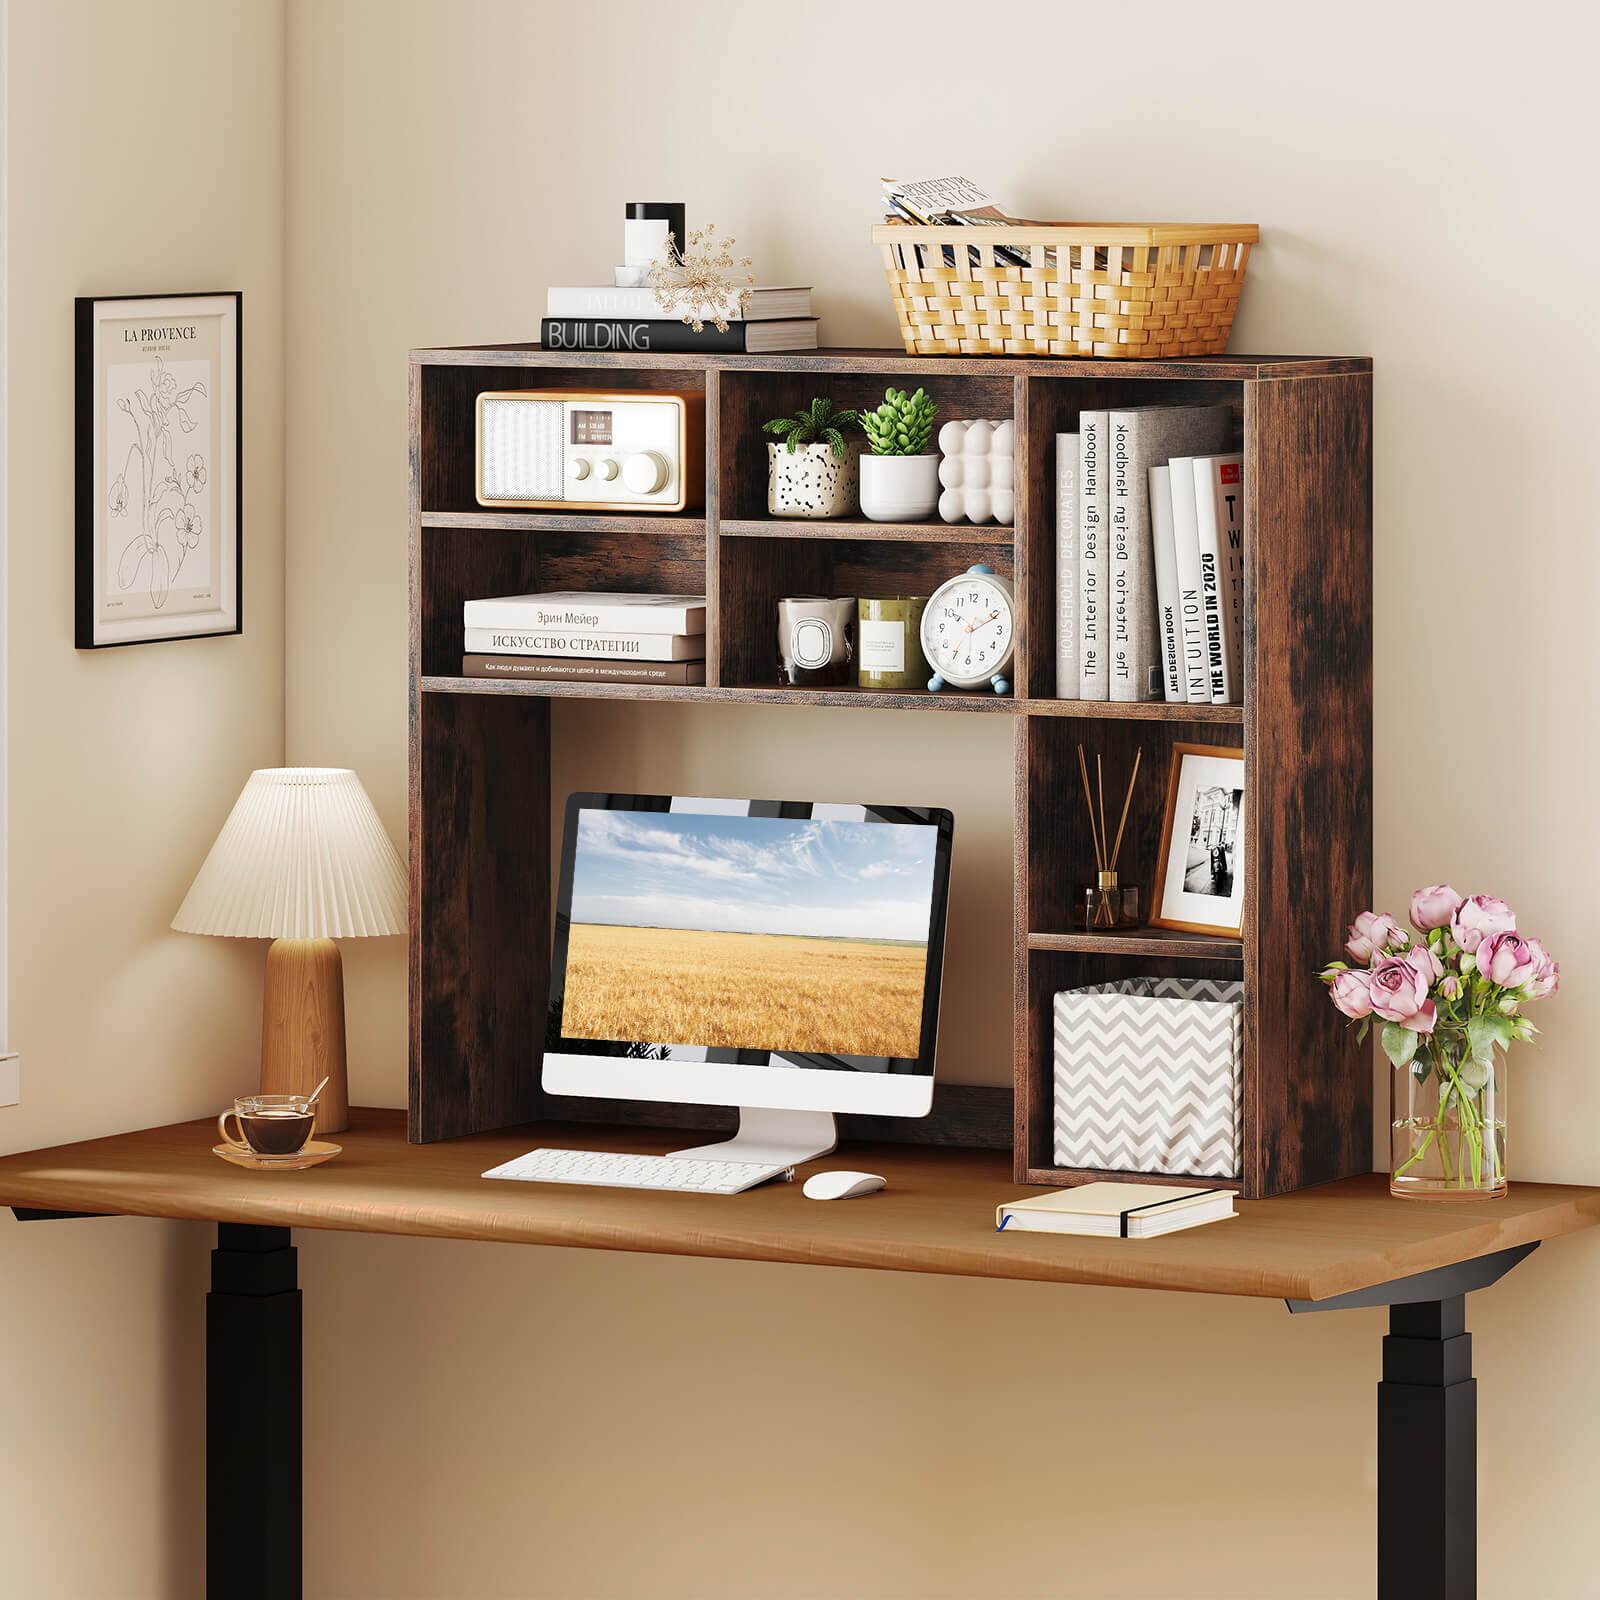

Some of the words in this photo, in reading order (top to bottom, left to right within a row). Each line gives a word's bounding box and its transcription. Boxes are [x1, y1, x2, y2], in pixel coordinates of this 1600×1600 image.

[913, 187, 989, 208] DESIGN
[124, 329, 138, 342] LA
[141, 326, 197, 342] PROVENCE
[548, 322, 650, 350] BUILDING
[1084, 423, 1097, 497] Handbook
[1060, 469, 1074, 559] DECORATES
[1084, 504, 1100, 560] Design
[1202, 553, 1216, 592] 2020
[956, 597, 964, 608] 11
[968, 593, 979, 603] 12
[985, 598, 989, 608] 1
[1084, 568, 1097, 641] Interior
[1205, 595, 1218, 611] IN
[537, 611, 562, 626] Эрин
[564, 611, 599, 628] Мейер
[944, 608, 954, 618] 10
[1060, 568, 1074, 659] HOUSEHOLD
[939, 623, 945, 633] 9
[996, 625, 1003, 635] 3
[492, 634, 566, 650] ИСКУССТВО
[569, 638, 640, 653] СТРАТЕГИИ
[942, 640, 948, 649] 8
[990, 641, 996, 650] 4
[1182, 589, 1205, 696] INTUITION
[1206, 614, 1222, 667] WORLD
[952, 650, 958, 660] 7
[964, 655, 971, 665] 6
[978, 651, 985, 661] 5
[485, 663, 496, 671] Как
[512, 665, 535, 673] думают
[540, 666, 576, 674] добиваются
[648, 669, 666, 678] среде
[1084, 650, 1097, 678] The
[1211, 670, 1225, 697] THE
